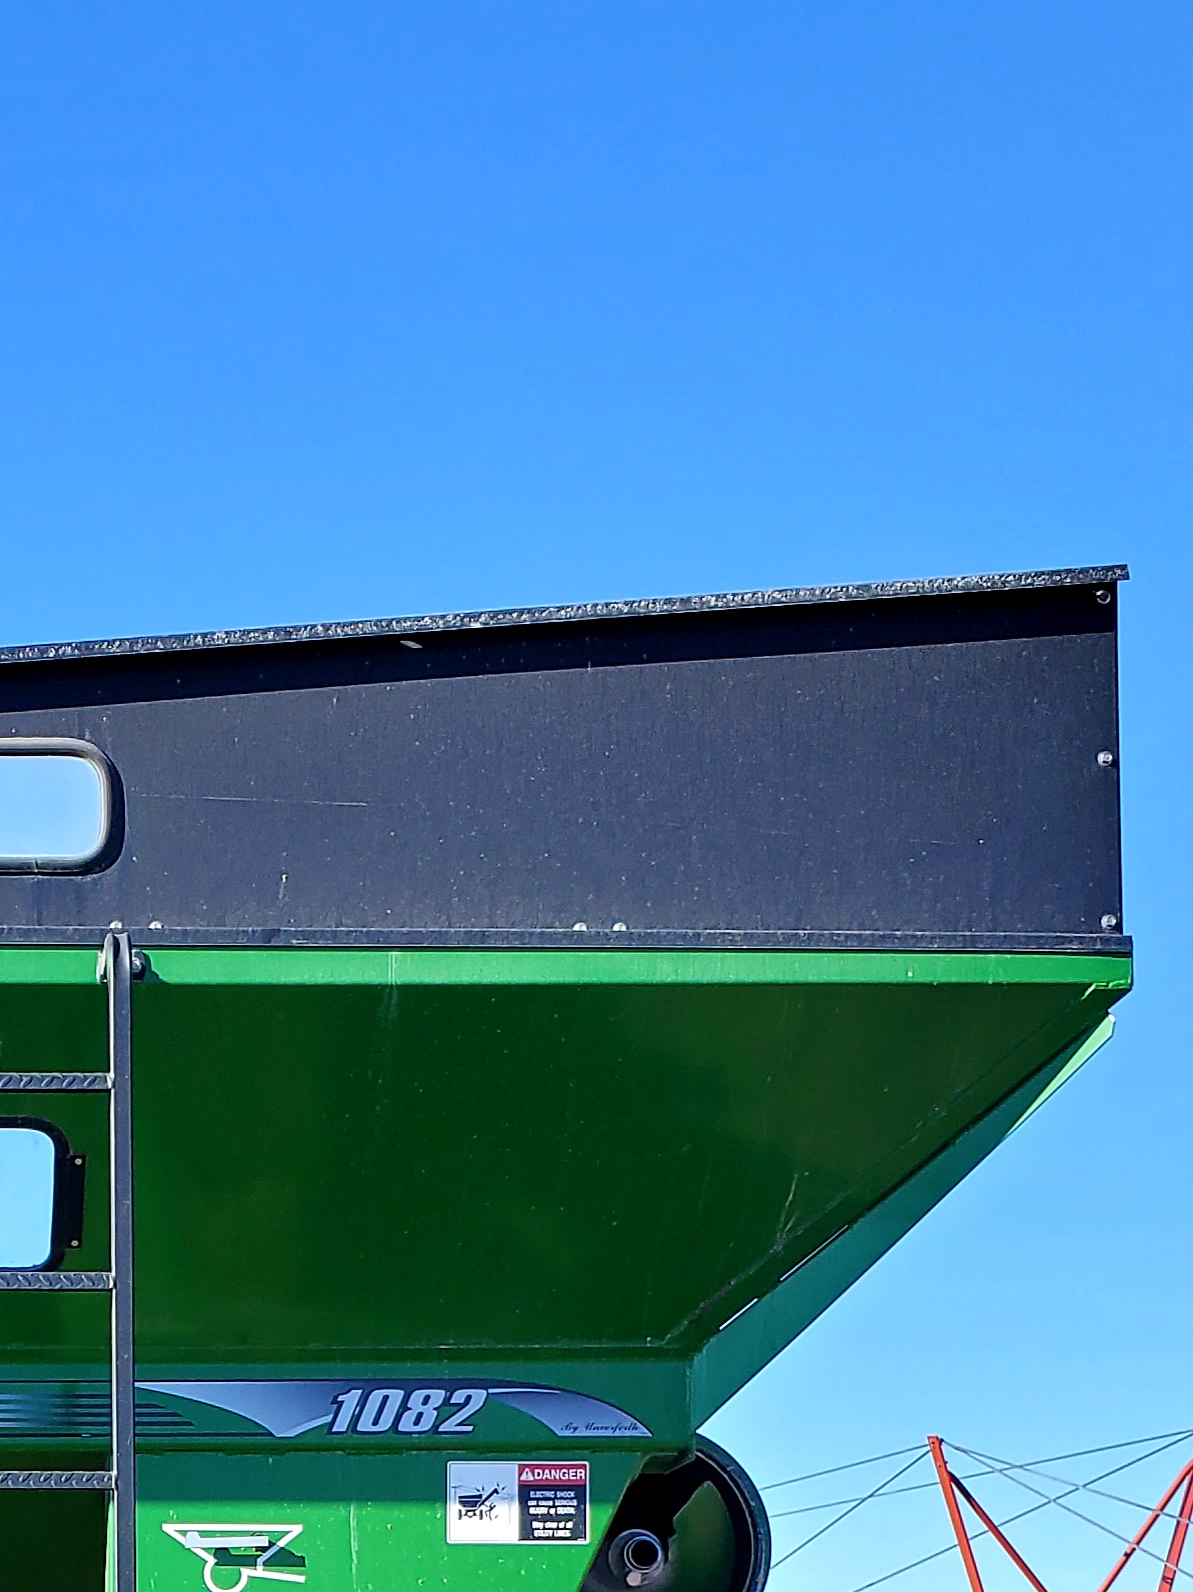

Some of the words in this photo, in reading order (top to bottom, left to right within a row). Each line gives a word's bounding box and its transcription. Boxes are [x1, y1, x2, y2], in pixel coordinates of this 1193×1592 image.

[328, 1387, 489, 1434] 1082
[560, 1422, 579, 1434] By
[534, 1468, 585, 1480] DANGER
